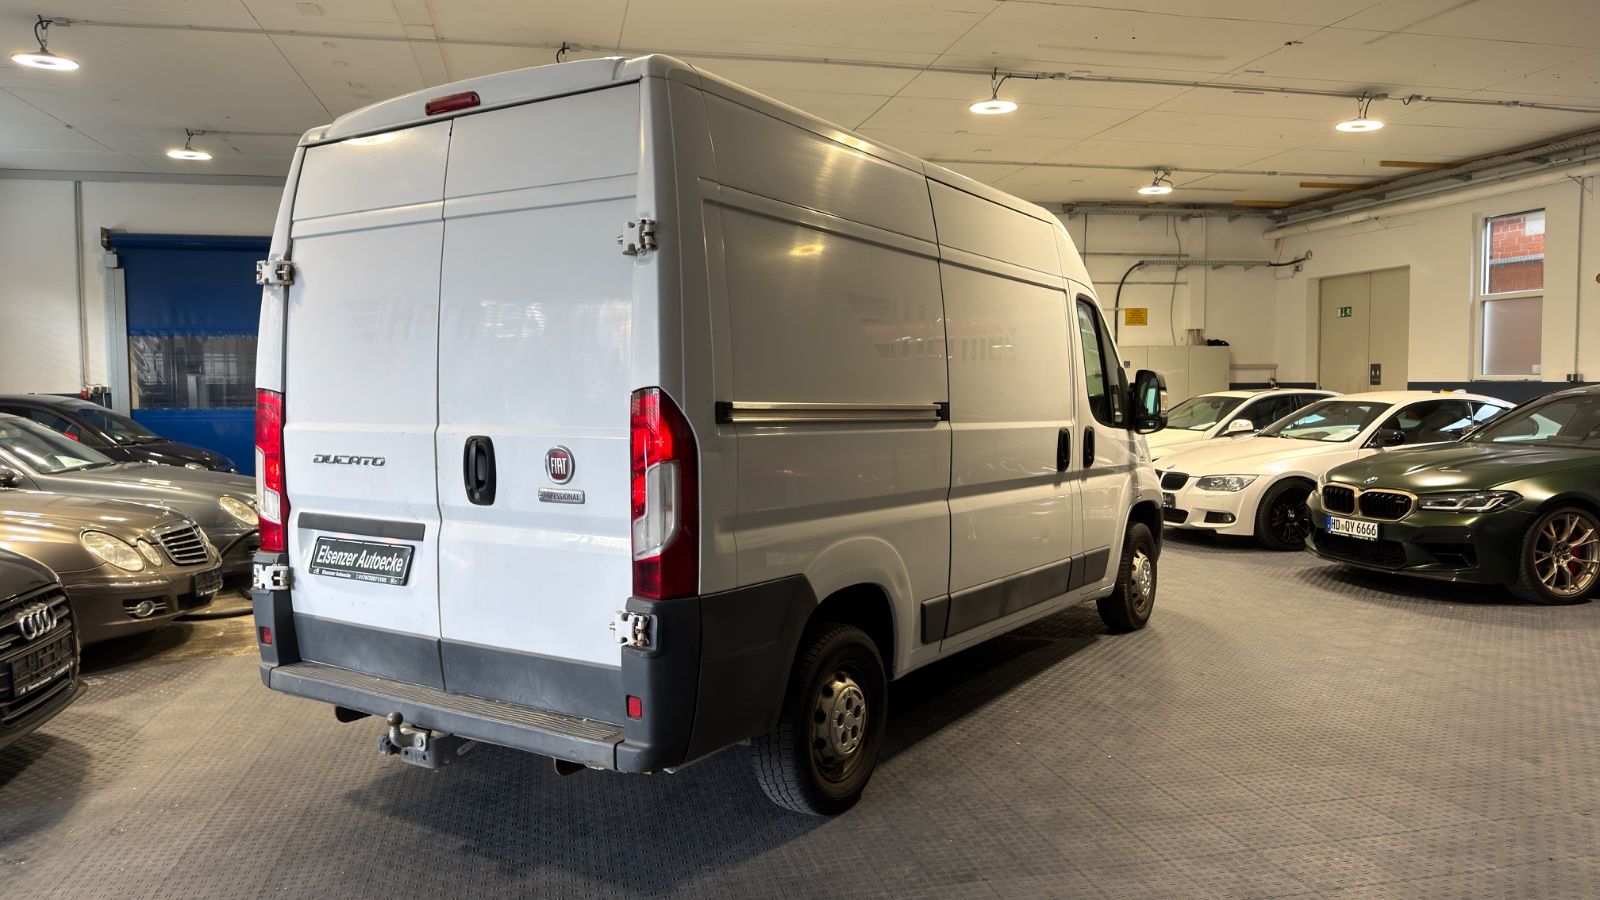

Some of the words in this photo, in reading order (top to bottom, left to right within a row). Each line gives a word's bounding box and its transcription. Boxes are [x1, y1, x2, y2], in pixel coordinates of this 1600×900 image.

[312, 454, 386, 467] DUCATO
[551, 457, 567, 475] FIAT
[1331, 518, 1340, 530] HD
[1356, 522, 1377, 536] 6666
[316, 544, 359, 568] Elsenzer
[355, 549, 403, 572] Autoecke
